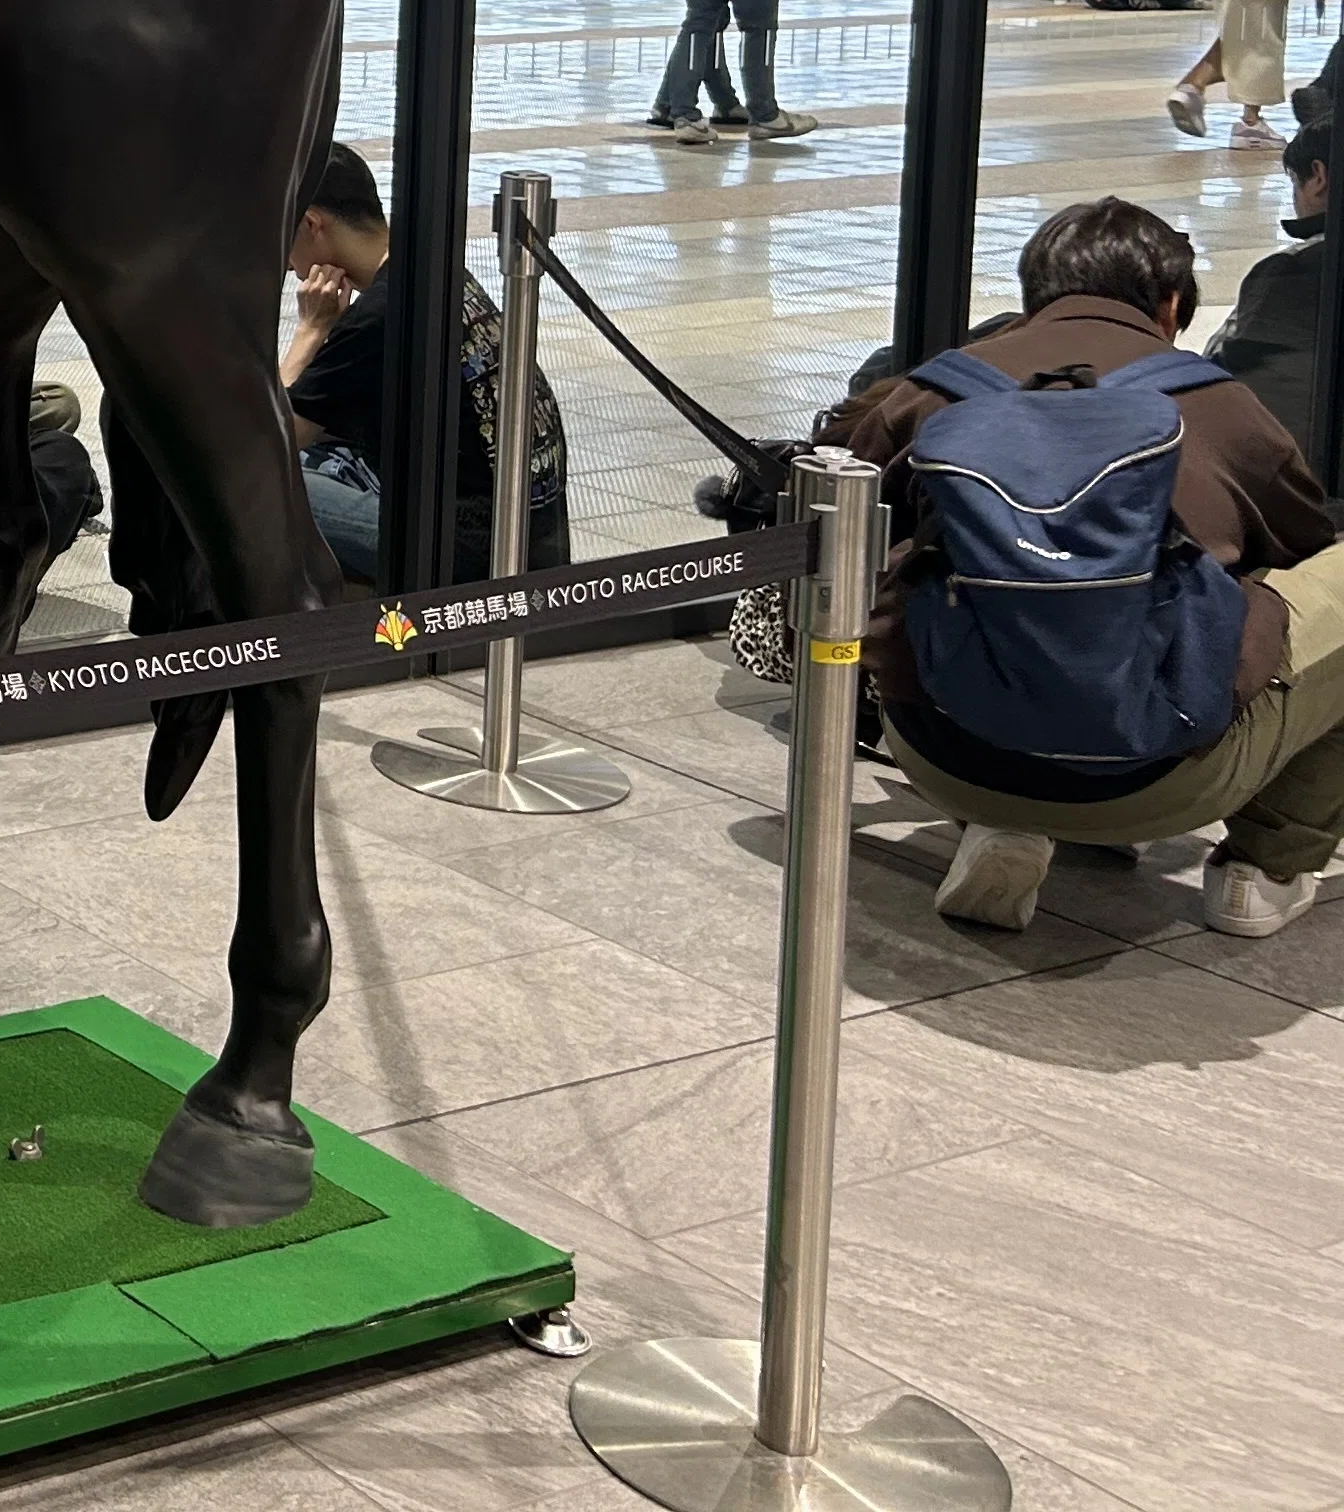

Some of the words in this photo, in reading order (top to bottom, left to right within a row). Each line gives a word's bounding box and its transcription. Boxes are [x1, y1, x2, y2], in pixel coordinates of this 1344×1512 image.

[420, 589, 529, 635] 京都競馬場
[547, 577, 615, 609] KYOTO
[621, 551, 745, 595] RACECOURSE
[47, 661, 129, 692] KYOTO
[134, 636, 281, 680] RACECOURSE
